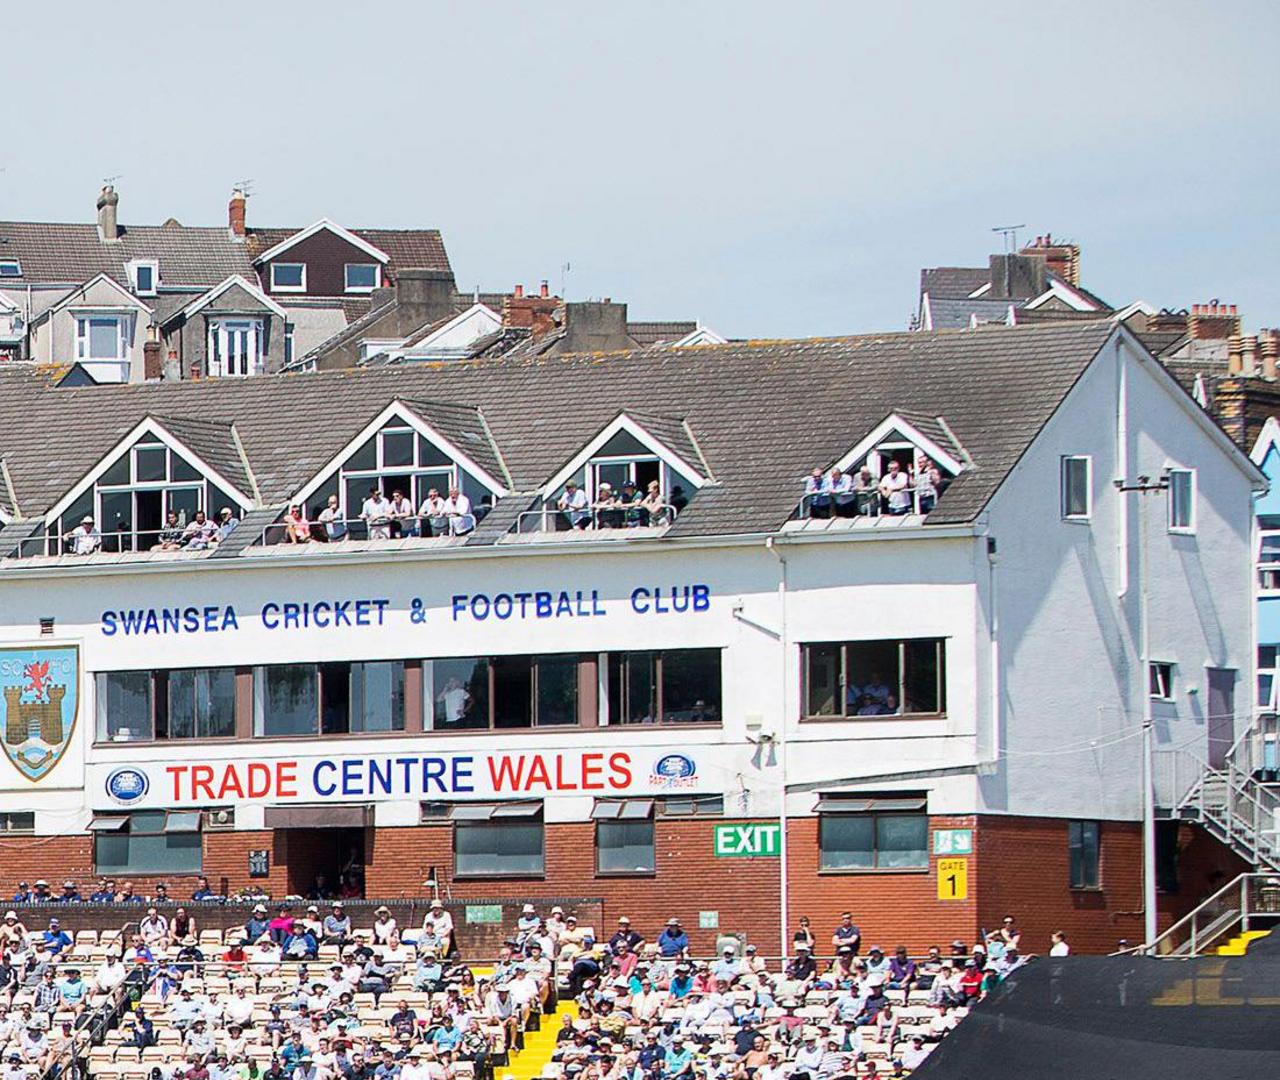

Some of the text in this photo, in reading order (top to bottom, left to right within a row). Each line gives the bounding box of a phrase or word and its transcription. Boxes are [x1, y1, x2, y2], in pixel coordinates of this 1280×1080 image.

[101, 584, 711, 636] SWANSEA CRICKET & FOOTBALL CLUB
[166, 752, 632, 801] TRADE CENTRE WALES
[717, 825, 780, 854] EXIT
[939, 861, 965, 871] GATE
[946, 874, 957, 897] 1
